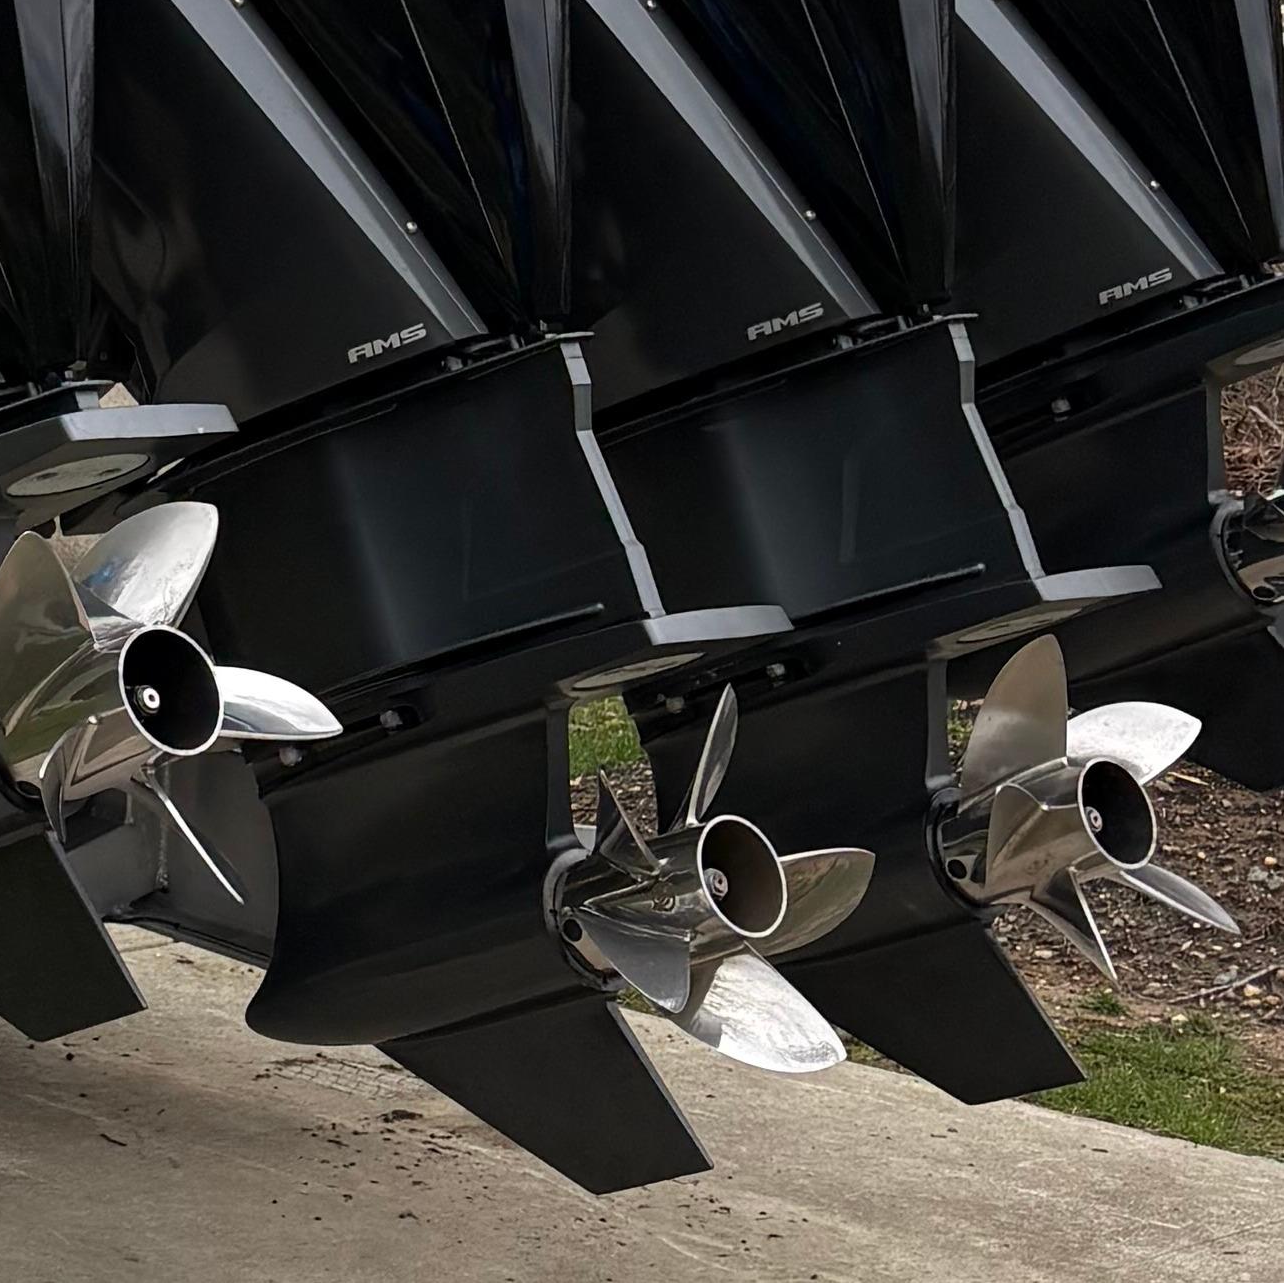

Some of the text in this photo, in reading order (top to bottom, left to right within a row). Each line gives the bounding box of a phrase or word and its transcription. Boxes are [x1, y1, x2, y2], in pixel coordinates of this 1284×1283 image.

[1098, 267, 1173, 305] AMS
[746, 302, 824, 341] AMS
[347, 323, 427, 364] AMS
